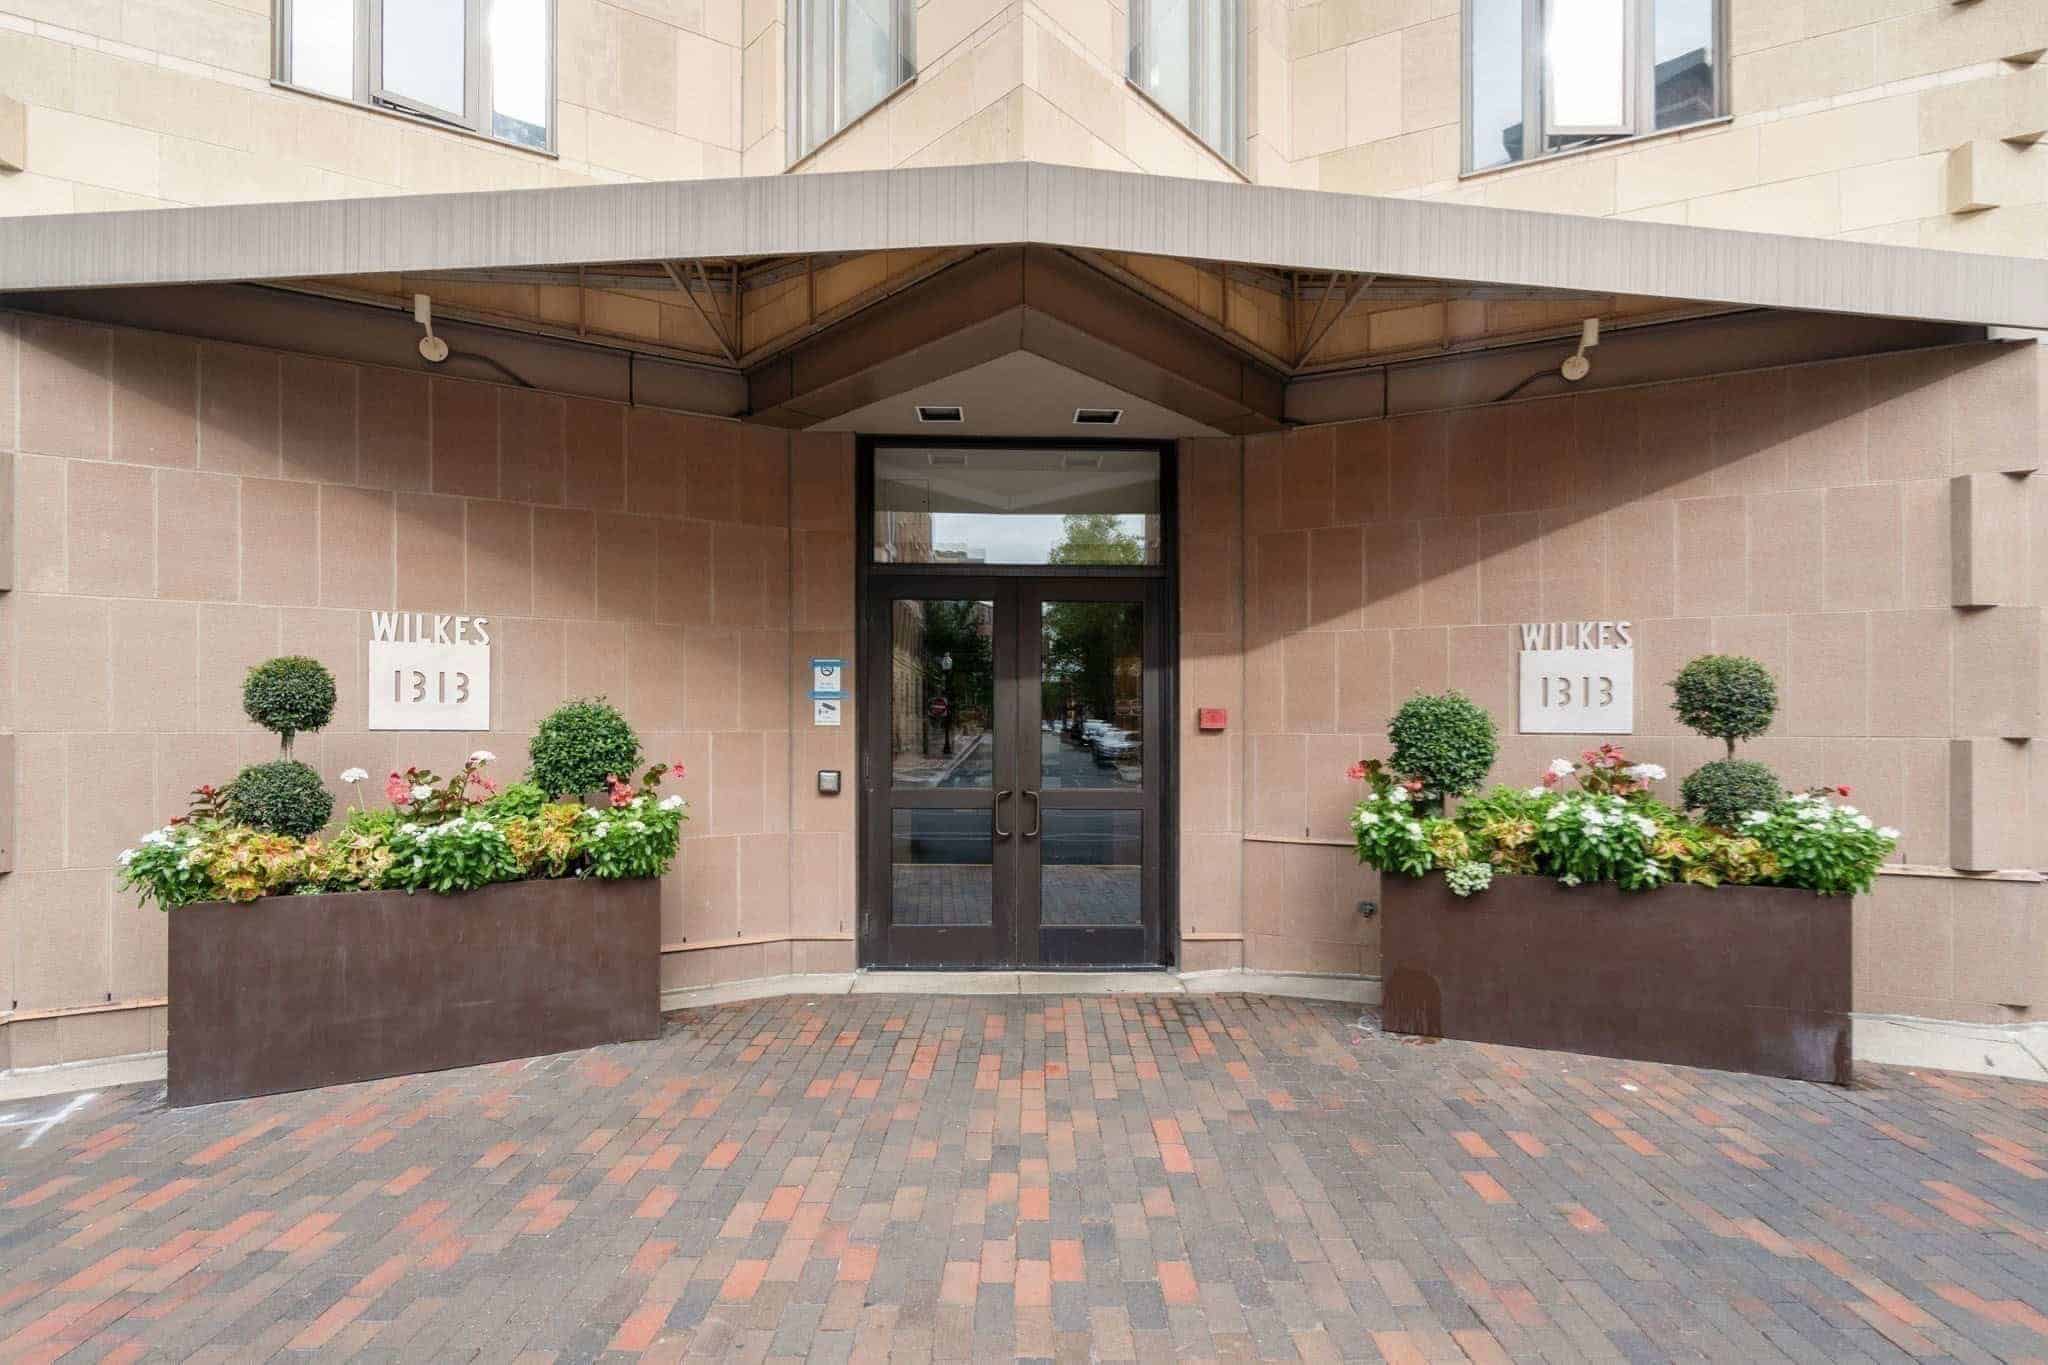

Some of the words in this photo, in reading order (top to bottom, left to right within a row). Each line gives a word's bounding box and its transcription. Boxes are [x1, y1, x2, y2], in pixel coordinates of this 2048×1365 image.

[371, 611, 490, 645] WILKES
[1520, 621, 1633, 651] WILKES
[394, 670, 469, 703] 1313
[1541, 676, 1613, 707] 1313
